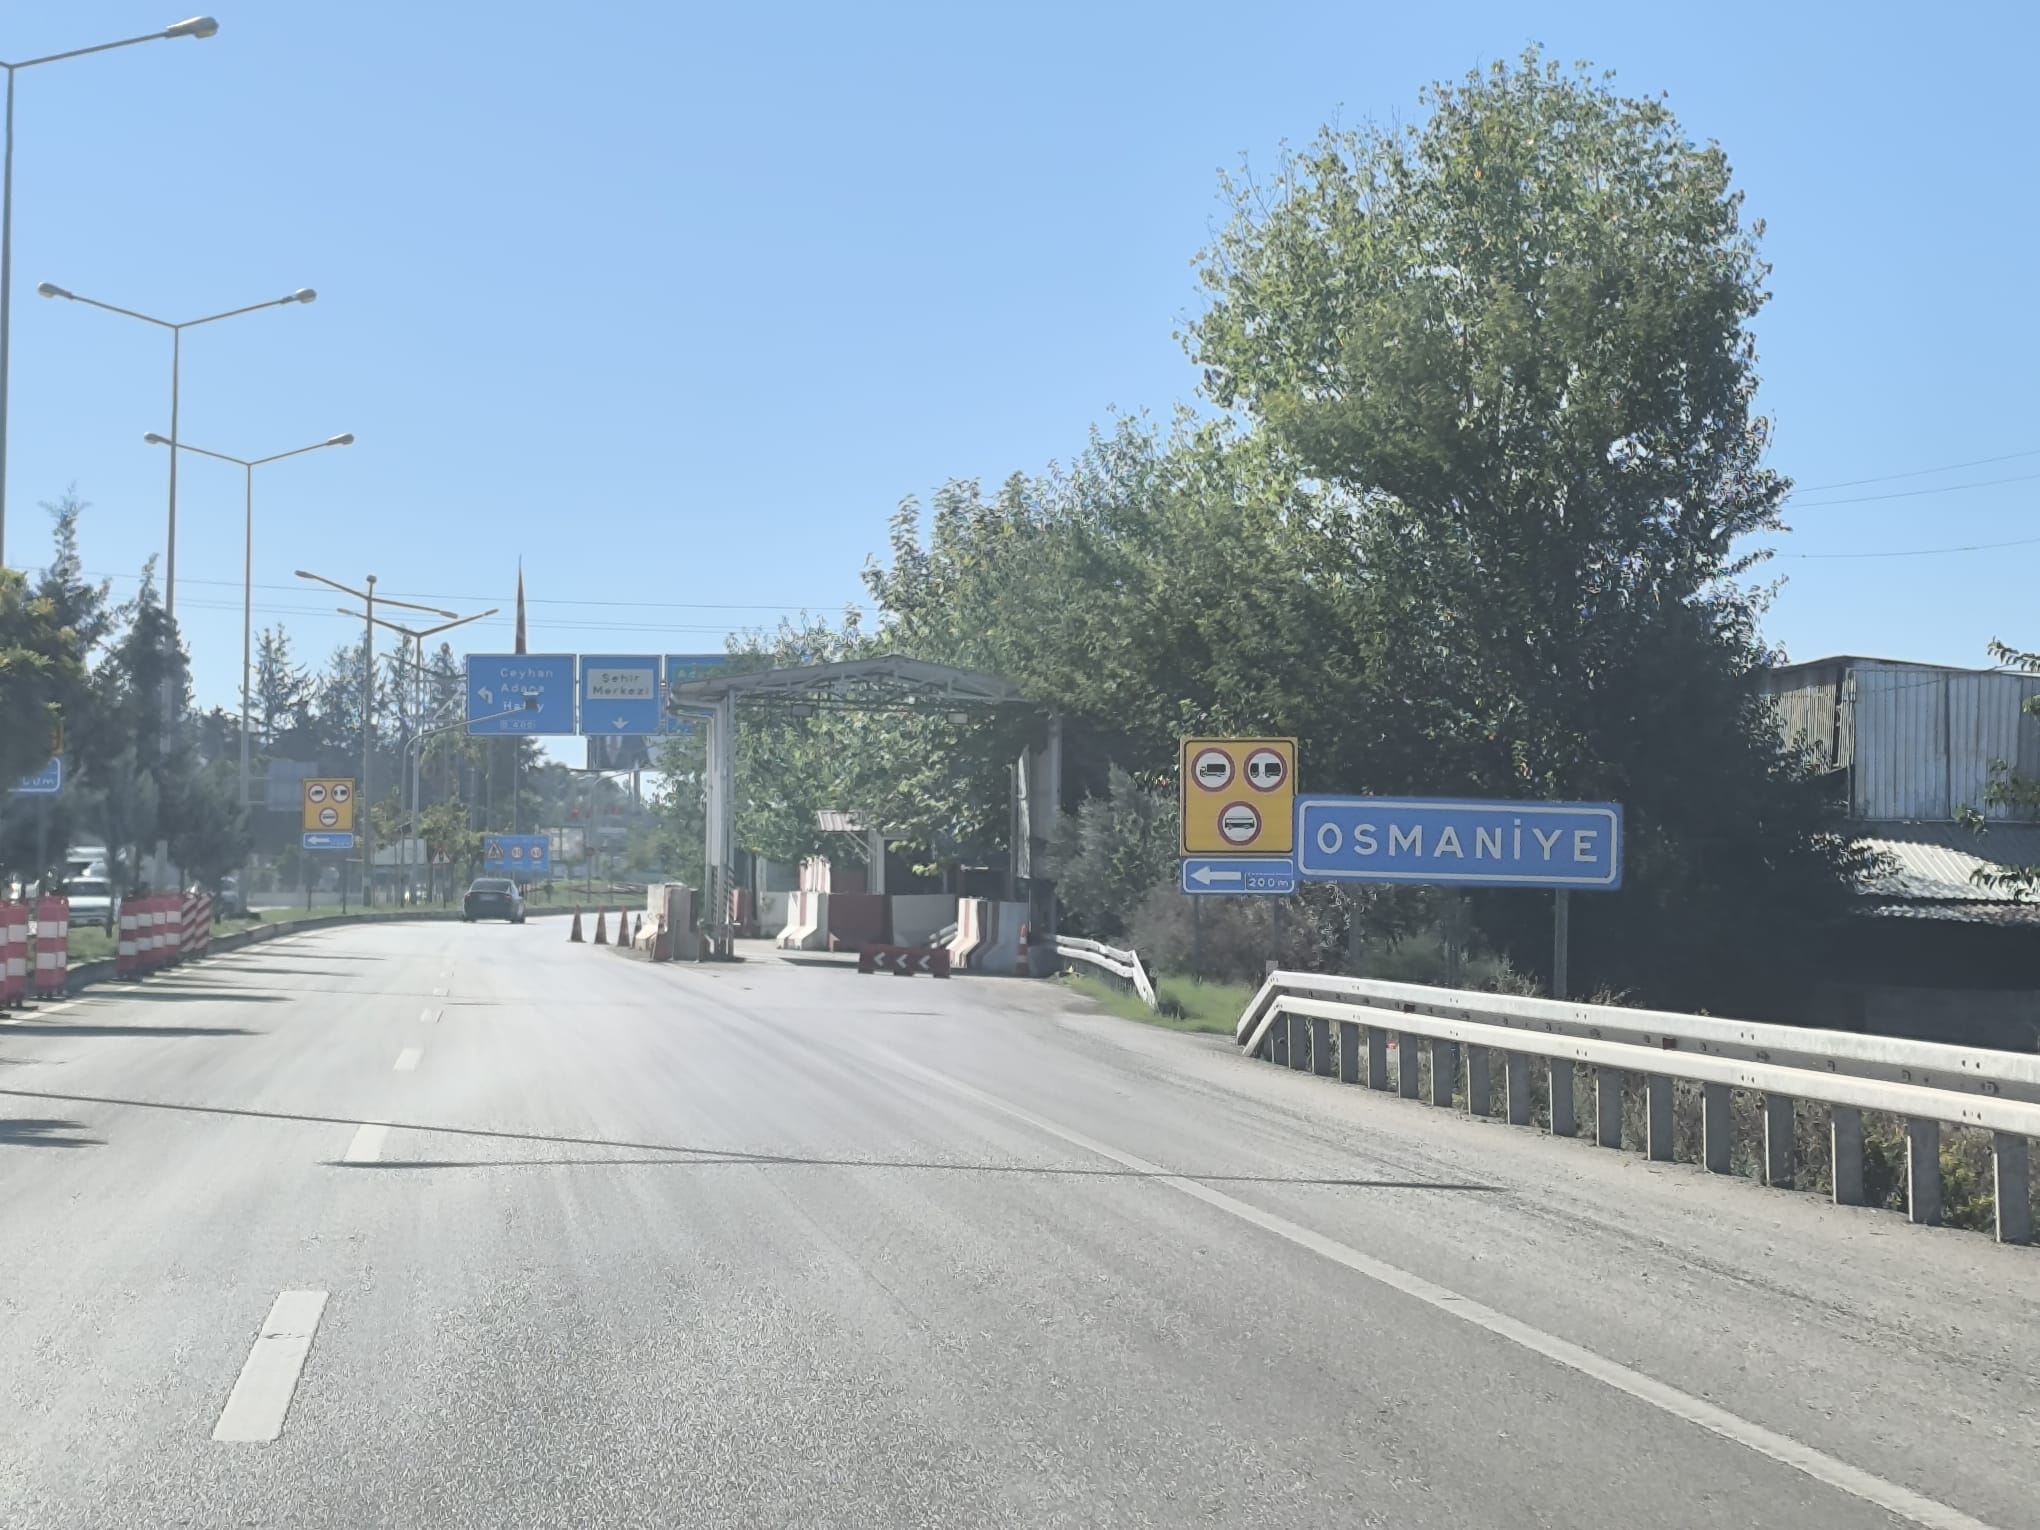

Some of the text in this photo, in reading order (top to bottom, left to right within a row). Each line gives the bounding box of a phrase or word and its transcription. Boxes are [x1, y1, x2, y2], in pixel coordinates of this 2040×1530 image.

[500, 667, 553, 680] Ceyhan
[593, 686, 649, 695] Merkezi
[503, 701, 545, 713] Haty
[1317, 818, 1598, 862] OSMANİYE
[1248, 878, 1289, 888] 200m
